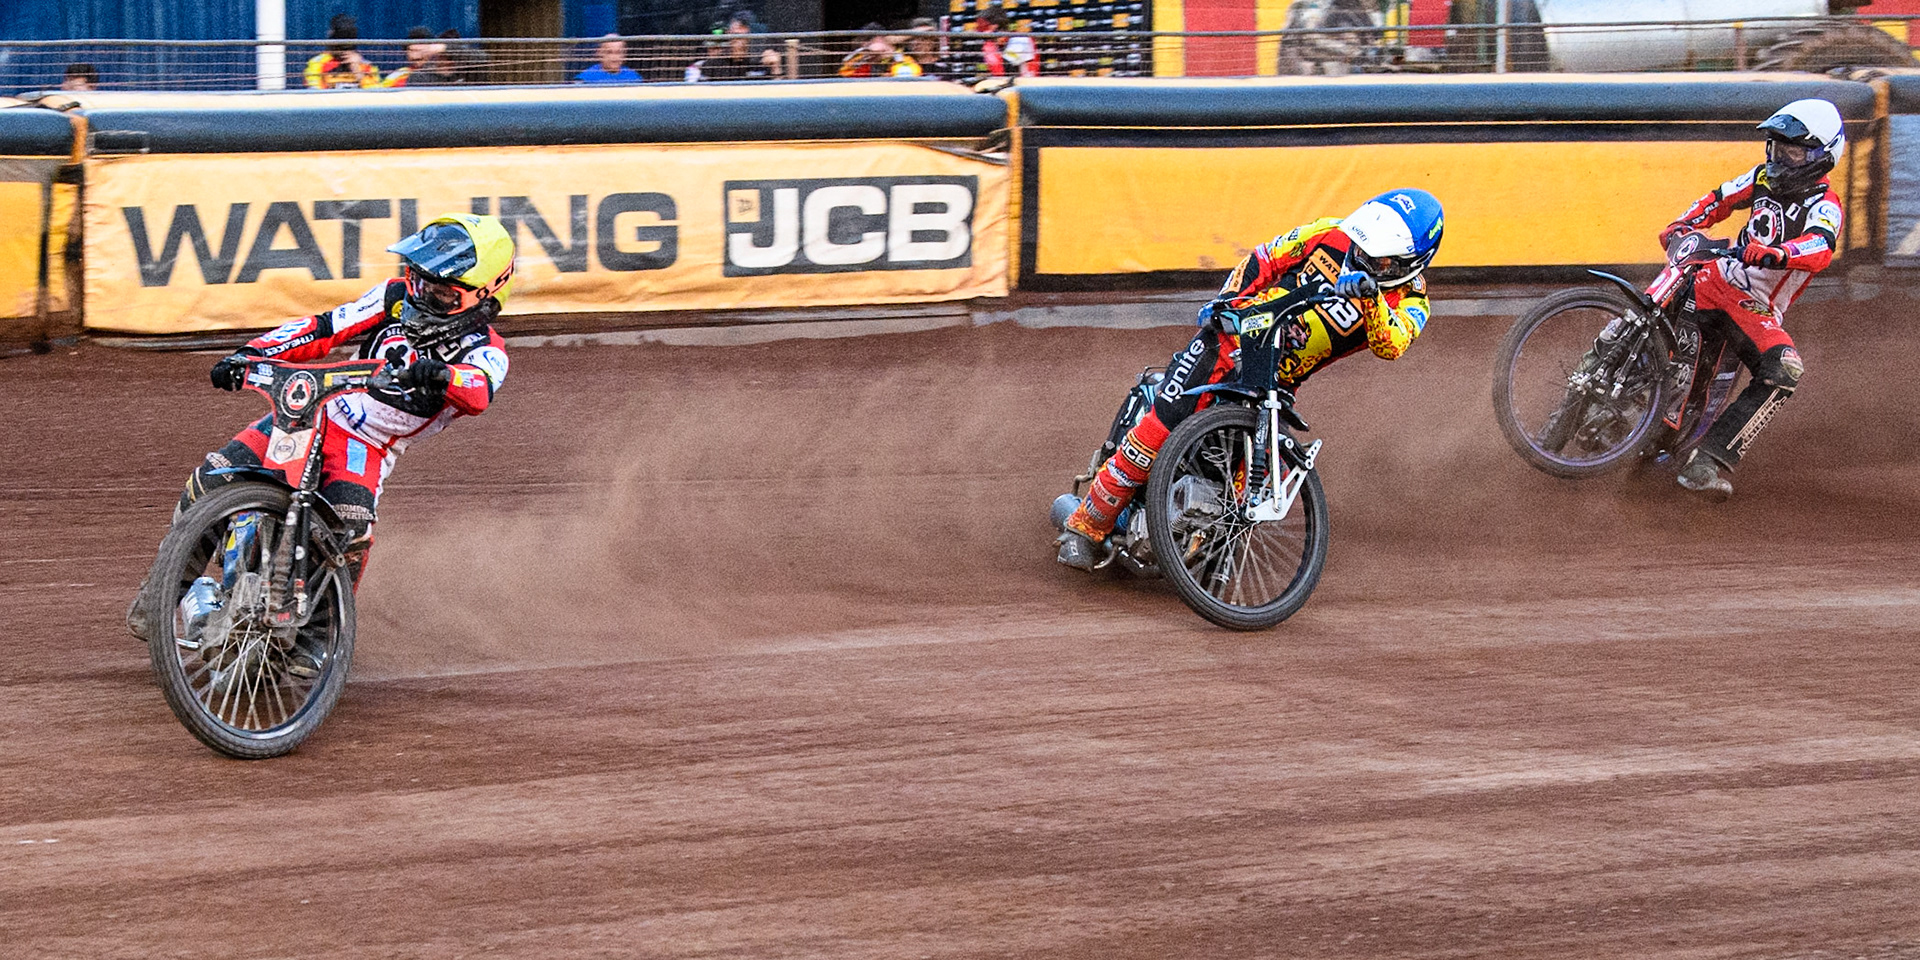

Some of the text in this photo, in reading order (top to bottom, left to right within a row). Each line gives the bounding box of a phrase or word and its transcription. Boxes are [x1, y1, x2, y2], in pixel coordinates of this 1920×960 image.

[120, 184, 974, 287] WATNG JCB
[1319, 255, 1342, 279] WATL
[1160, 338, 1206, 403] ignite
[1121, 436, 1151, 468] JCB
